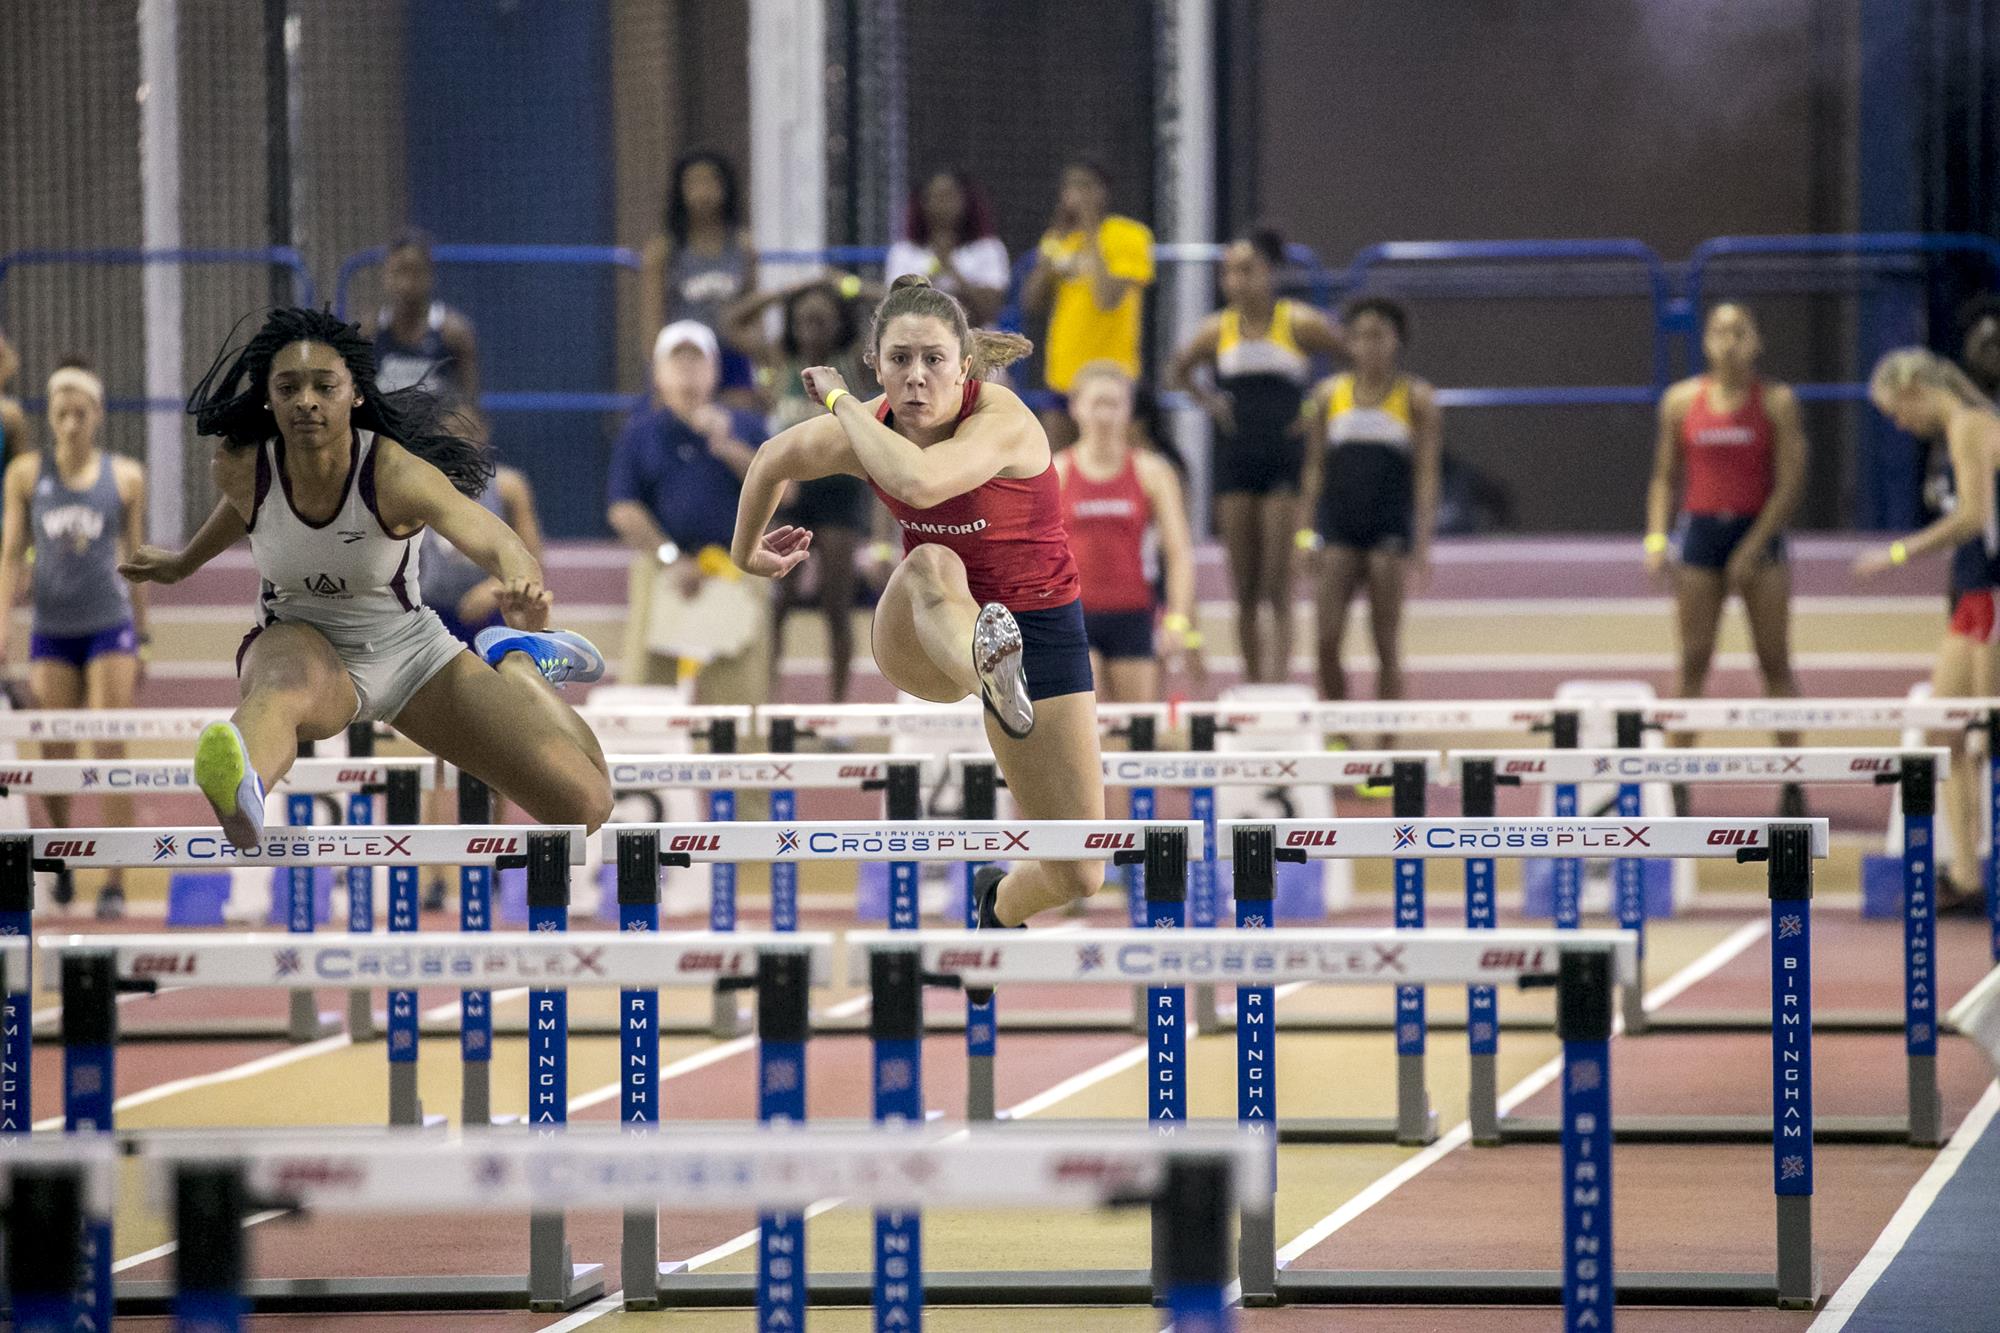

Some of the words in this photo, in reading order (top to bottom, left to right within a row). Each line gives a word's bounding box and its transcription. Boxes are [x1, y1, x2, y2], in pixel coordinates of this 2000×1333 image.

[838, 765, 880, 779] GILL
[1344, 762, 1384, 776] GILL
[1505, 759, 1545, 773] GILL
[1850, 758, 1892, 772] GILL
[336, 769, 378, 783] GILL
[670, 835, 720, 851] GILL
[809, 830, 1029, 853] CROSSPLEX
[1085, 833, 1135, 849] GILL
[1286, 831, 1336, 846] GILL
[1427, 826, 1650, 848] CROSSPLEX
[1707, 829, 1759, 845] GILL
[44, 841, 96, 857] GILL
[466, 838, 518, 853] GILL
[1782, 957, 1801, 1136] BIRMINGHAM
[1574, 1112, 1600, 1329] BIRMINGHA
